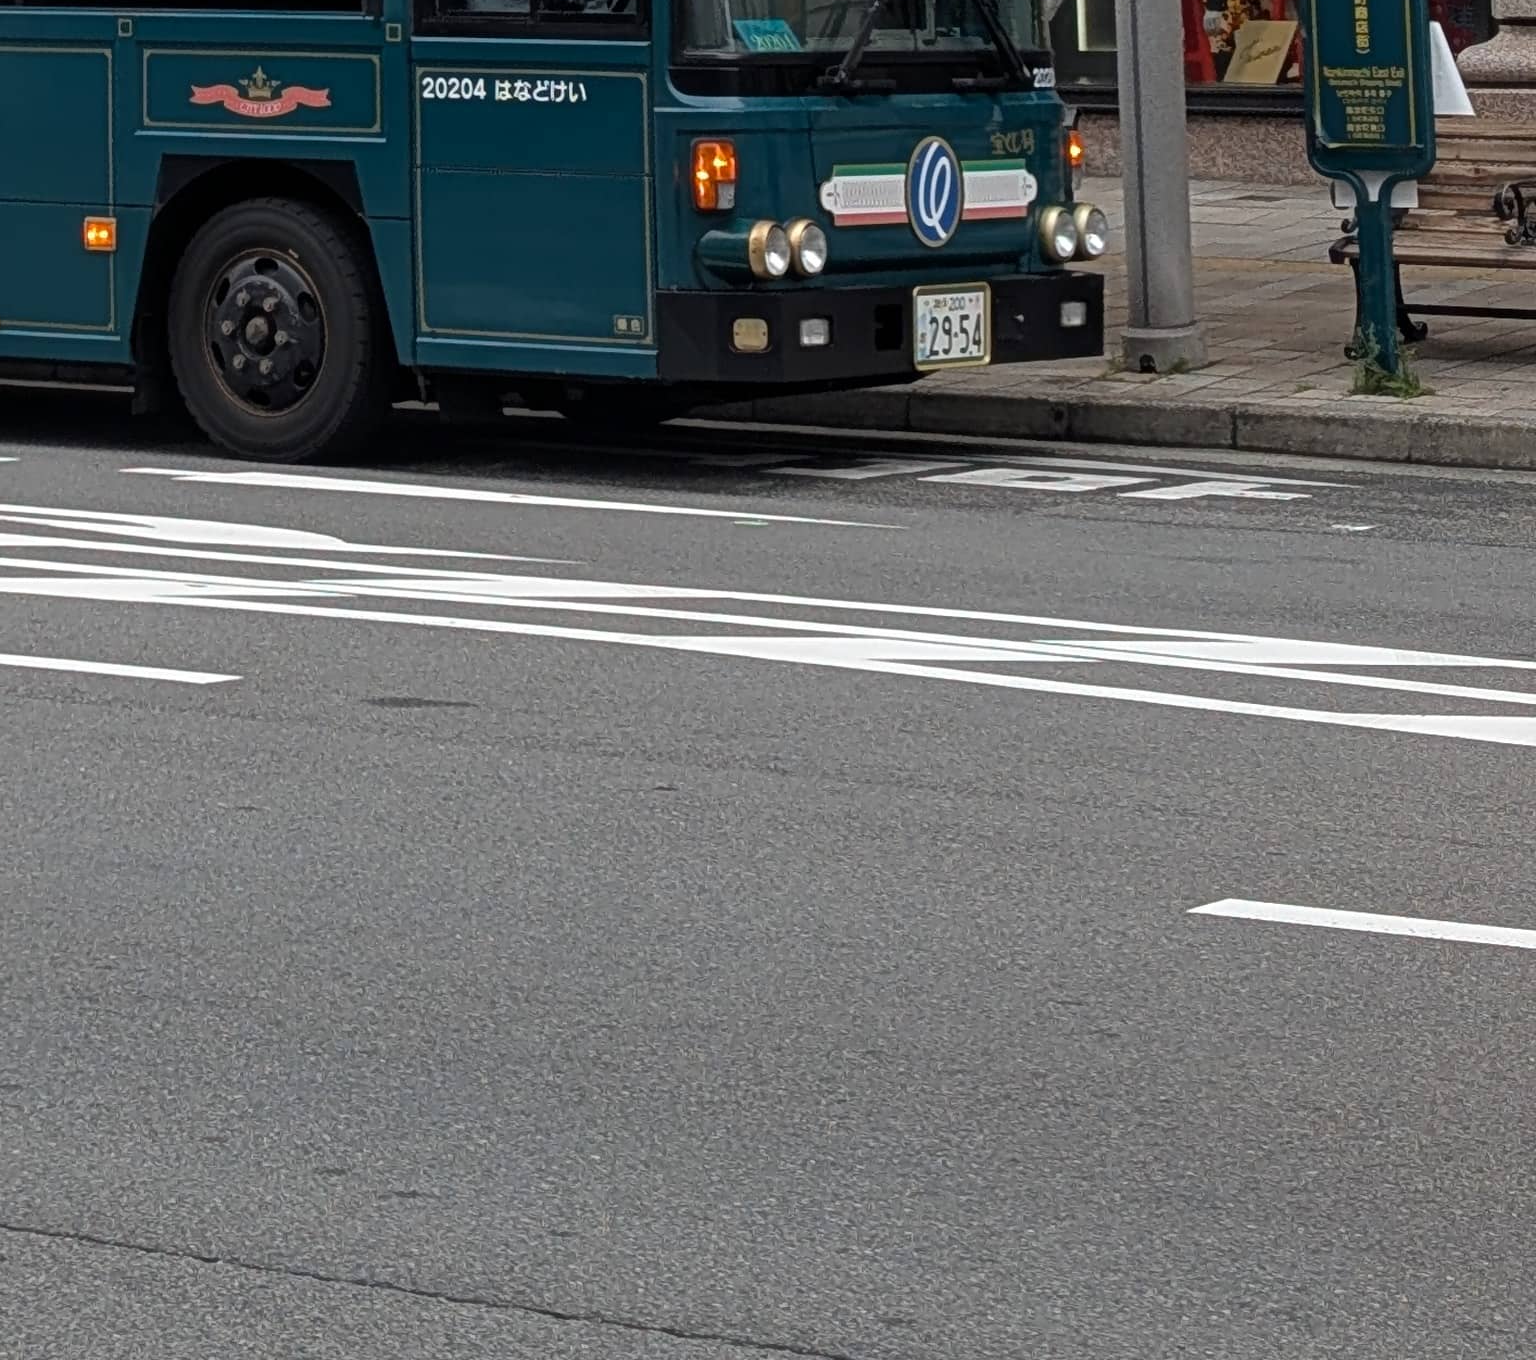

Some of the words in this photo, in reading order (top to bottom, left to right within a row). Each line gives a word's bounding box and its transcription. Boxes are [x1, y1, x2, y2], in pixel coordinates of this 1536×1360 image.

[421, 77, 486, 100] 20204
[494, 78, 587, 104] はなどけい
[948, 296, 966, 311] 200
[928, 312, 982, 356] 29-54
